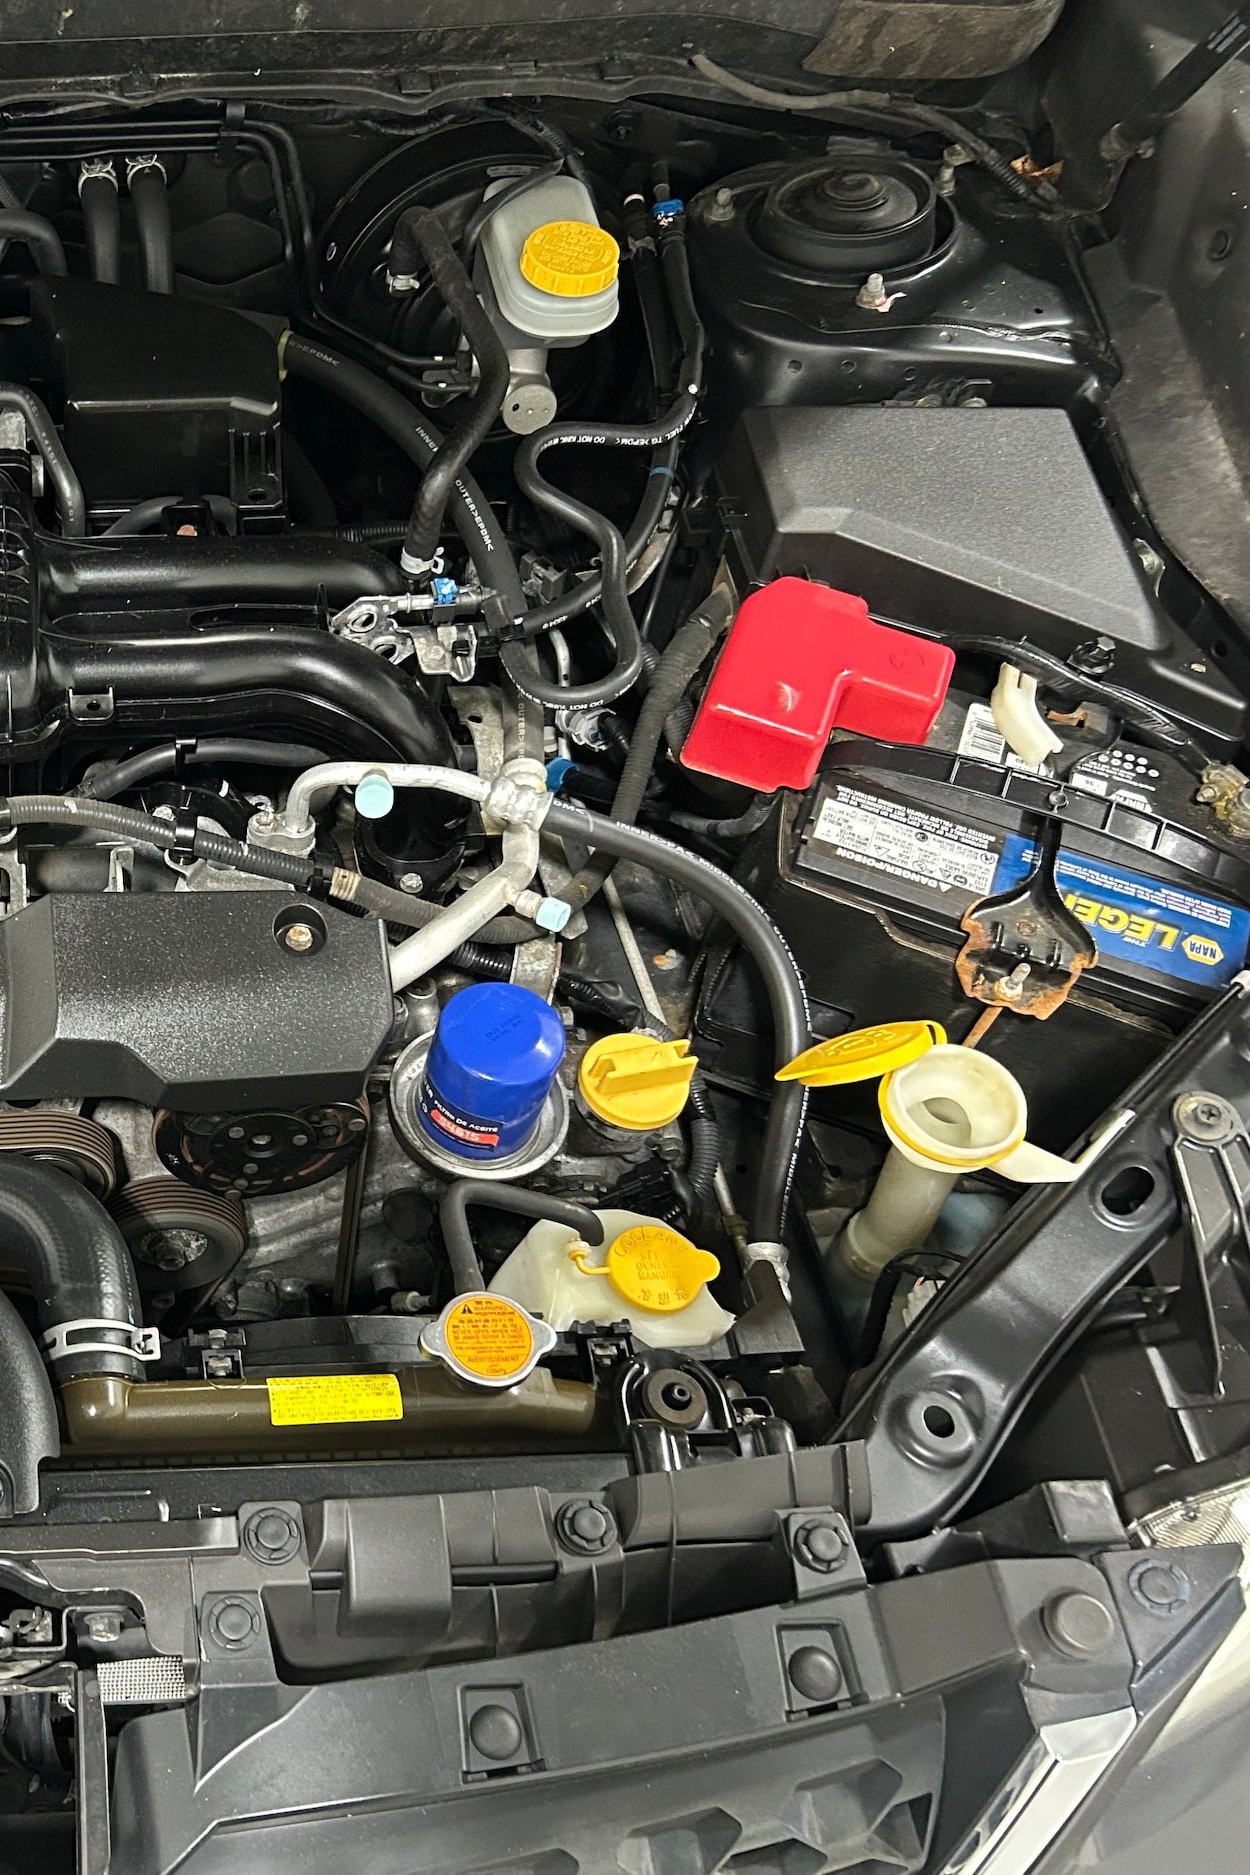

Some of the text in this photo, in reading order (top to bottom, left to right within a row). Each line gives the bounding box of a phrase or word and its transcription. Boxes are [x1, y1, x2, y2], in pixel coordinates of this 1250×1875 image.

[577, 435, 592, 444] NOT
[593, 435, 606, 444] DO
[455, 479, 495, 552] OUTER>EPDM<
[835, 846, 939, 889] DANGER/POISON
[1188, 939, 1218, 960] NAPA
[434, 1100, 455, 1121] FILTRO
[455, 1116, 467, 1127] DE
[469, 1123, 499, 1133] ACEITE
